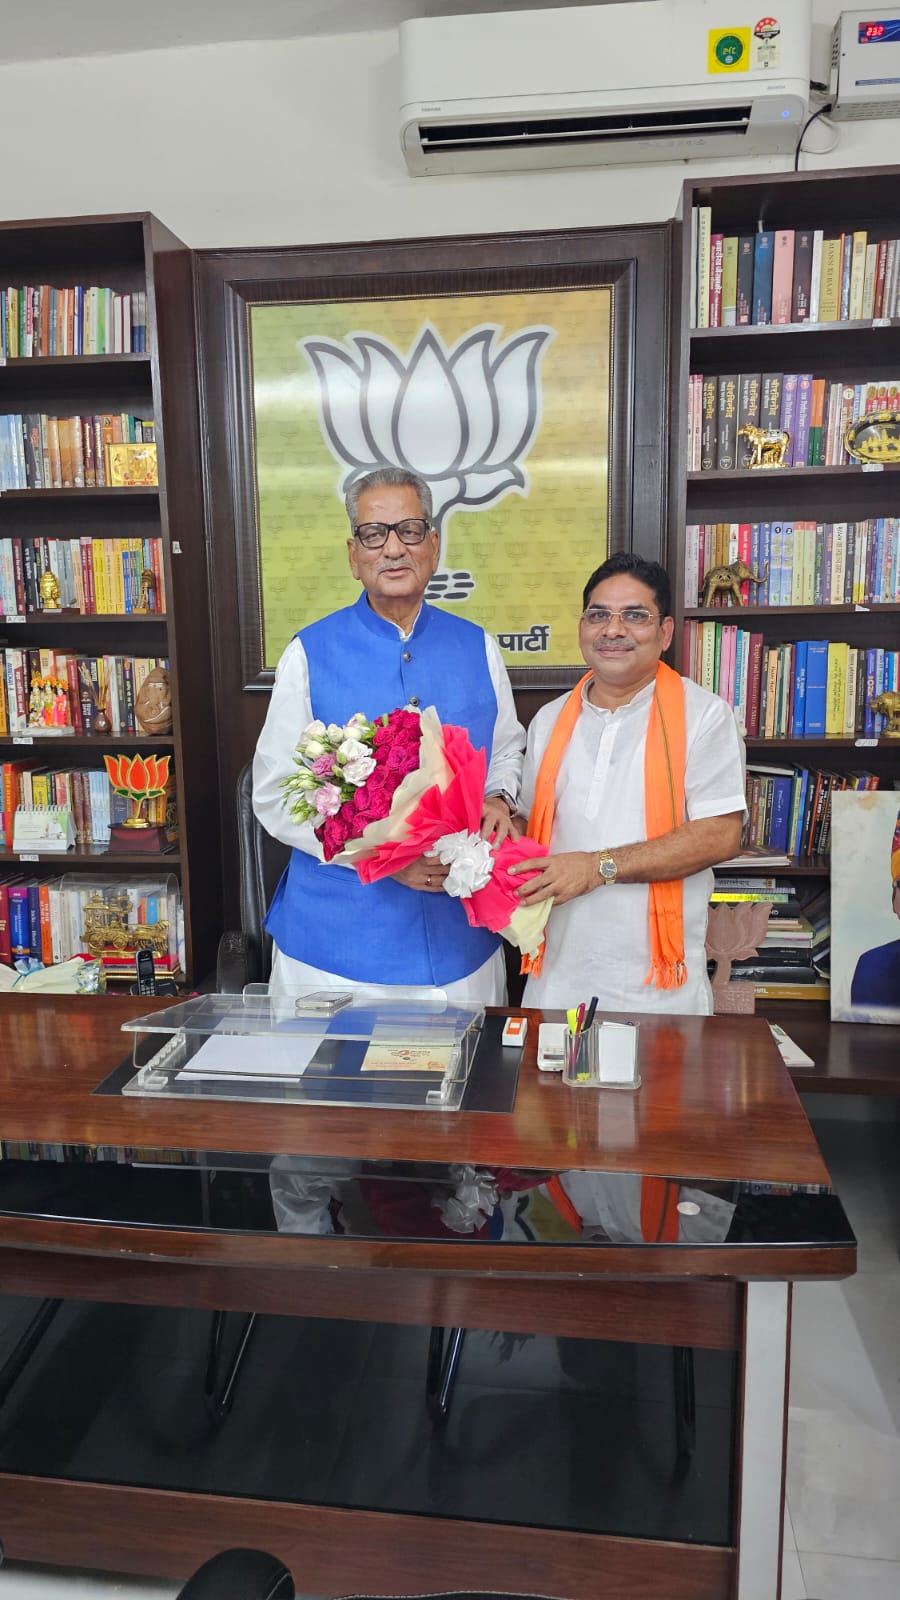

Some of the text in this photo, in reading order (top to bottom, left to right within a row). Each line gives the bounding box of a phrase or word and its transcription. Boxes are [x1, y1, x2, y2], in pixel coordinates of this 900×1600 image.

[866, 26, 885, 37] 232
[827, 242, 835, 266] MANN
[497, 625, 550, 652] पार्टी
